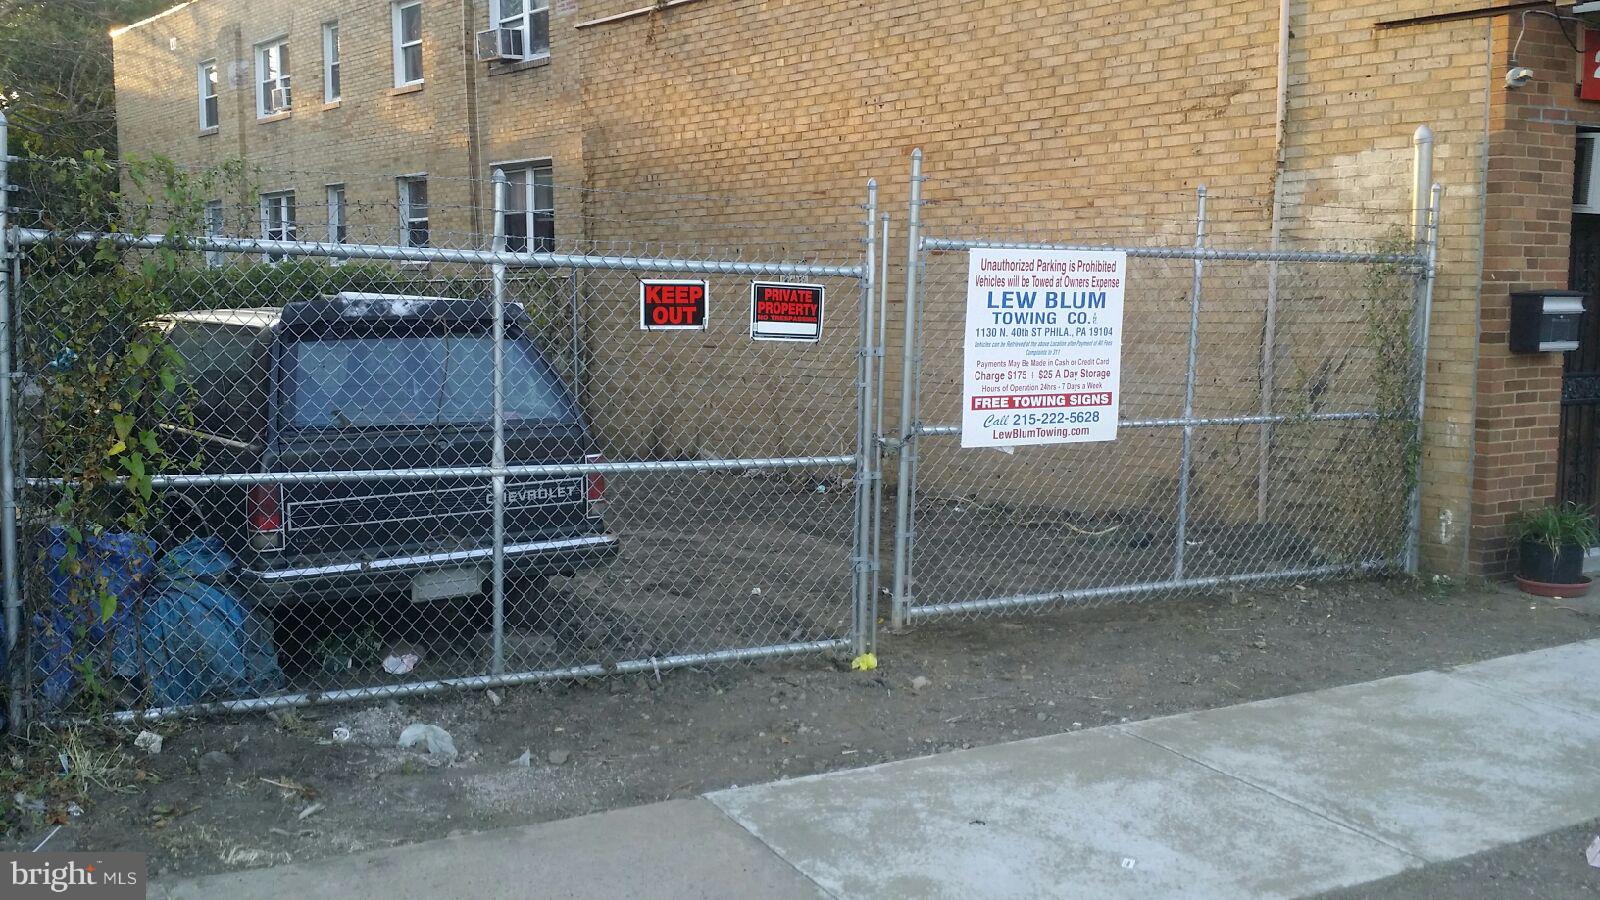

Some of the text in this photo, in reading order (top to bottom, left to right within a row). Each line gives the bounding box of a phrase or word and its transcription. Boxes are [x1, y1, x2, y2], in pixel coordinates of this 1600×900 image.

[980, 258, 1116, 275] Unauthorized Parking is Prohibited
[976, 275, 1120, 291] Vehicles will be Towed at Owners Expense
[646, 286, 702, 304] KEEP
[765, 288, 813, 302] PRIVATE
[987, 291, 1106, 309] LEW BLUM
[652, 306, 696, 324] OUT
[758, 302, 817, 316] PROPERTY
[992, 312, 1057, 325] TOWING
[1068, 312, 1090, 324] CO.
[976, 328, 996, 337] 1130
[1000, 328, 1008, 337] N.
[1011, 328, 1029, 337] 40th
[1032, 328, 1041, 337] ST
[1076, 327, 1086, 337] PA
[1089, 327, 1113, 336] 19104
[976, 360, 1006, 368] Payments
[1008, 360, 1020, 368] May
[975, 371, 1005, 382] Charge
[1008, 370, 1026, 380] $175
[1039, 370, 1052, 379] $25
[1055, 370, 1061, 378] A
[1064, 370, 1077, 380] Day
[1080, 369, 1110, 379] Storage
[1010, 384, 1038, 392] Operation
[1067, 383, 1080, 391] Days
[974, 393, 1109, 408] FREE TOWING SIGNS
[983, 411, 1100, 428] Call 215-222-5628
[993, 426, 1089, 440] LewBlumTowing.com
